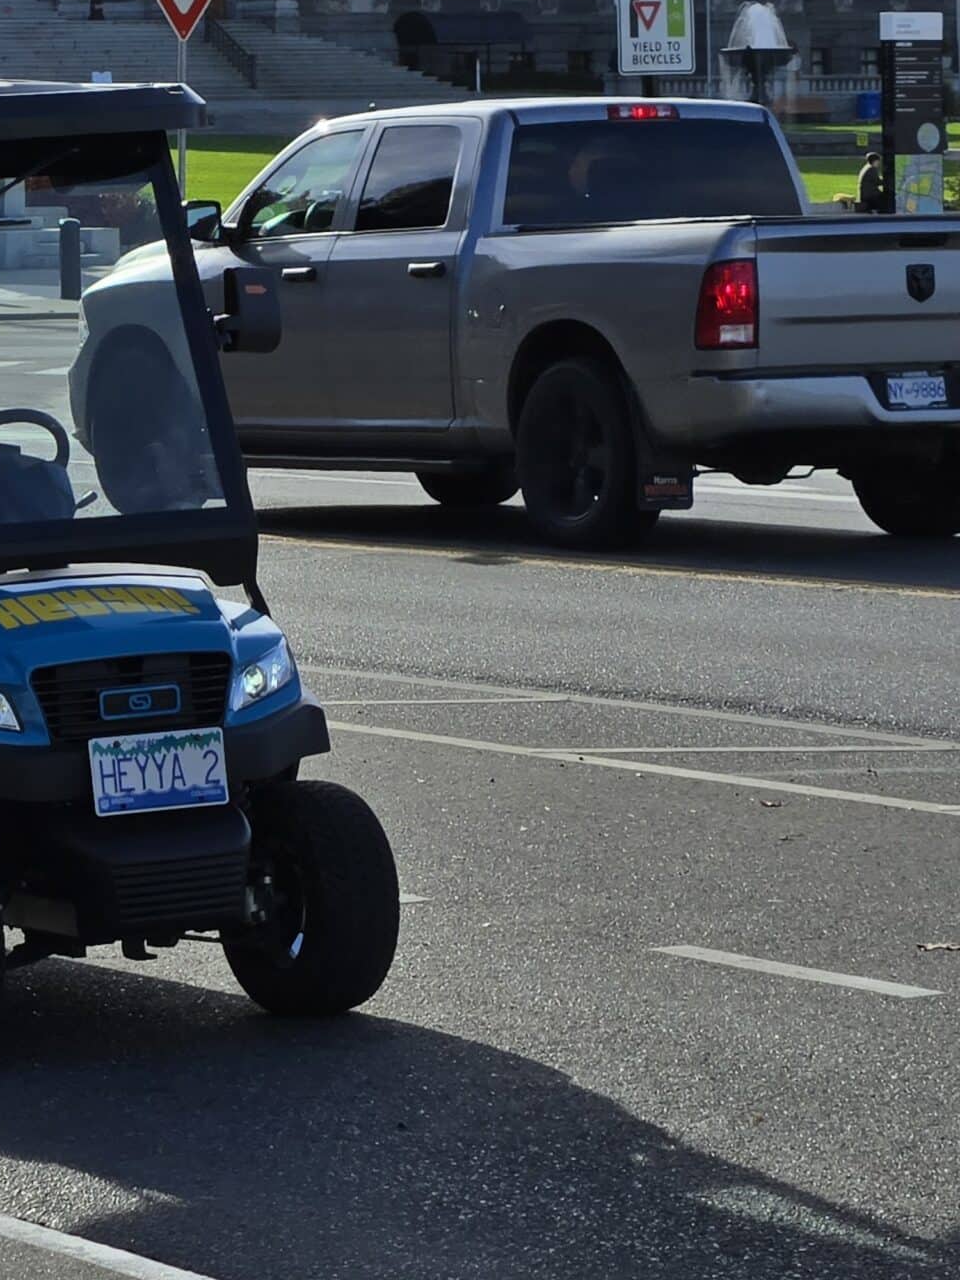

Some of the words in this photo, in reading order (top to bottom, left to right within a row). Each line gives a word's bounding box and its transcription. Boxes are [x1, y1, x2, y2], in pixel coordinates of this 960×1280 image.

[632, 41, 662, 53] YIELD
[666, 41, 681, 52] TO
[632, 54, 682, 66] BICYCLES
[99, 752, 187, 794] HEYYA
[203, 749, 221, 785] 2
